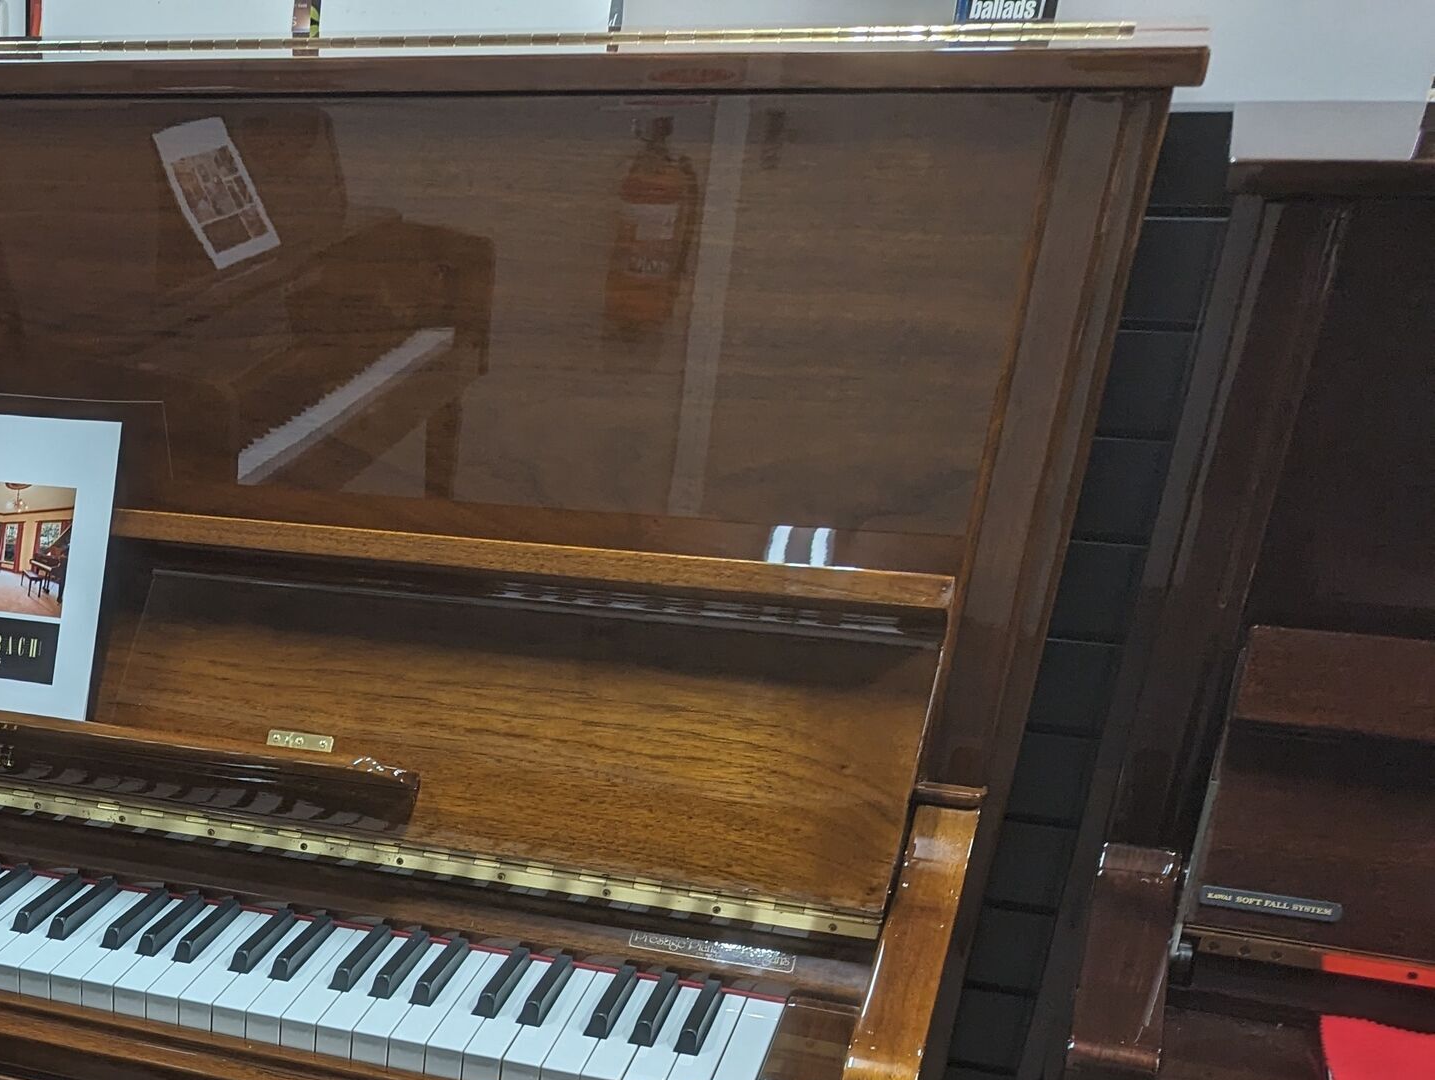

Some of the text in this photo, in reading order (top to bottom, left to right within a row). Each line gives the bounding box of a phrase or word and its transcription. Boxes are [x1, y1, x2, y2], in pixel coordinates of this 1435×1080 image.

[969, 0, 1037, 20] ballads
[1235, 896, 1263, 906] SOFT
[1264, 900, 1290, 910] FALL
[1291, 904, 1333, 916] SYSTEM
